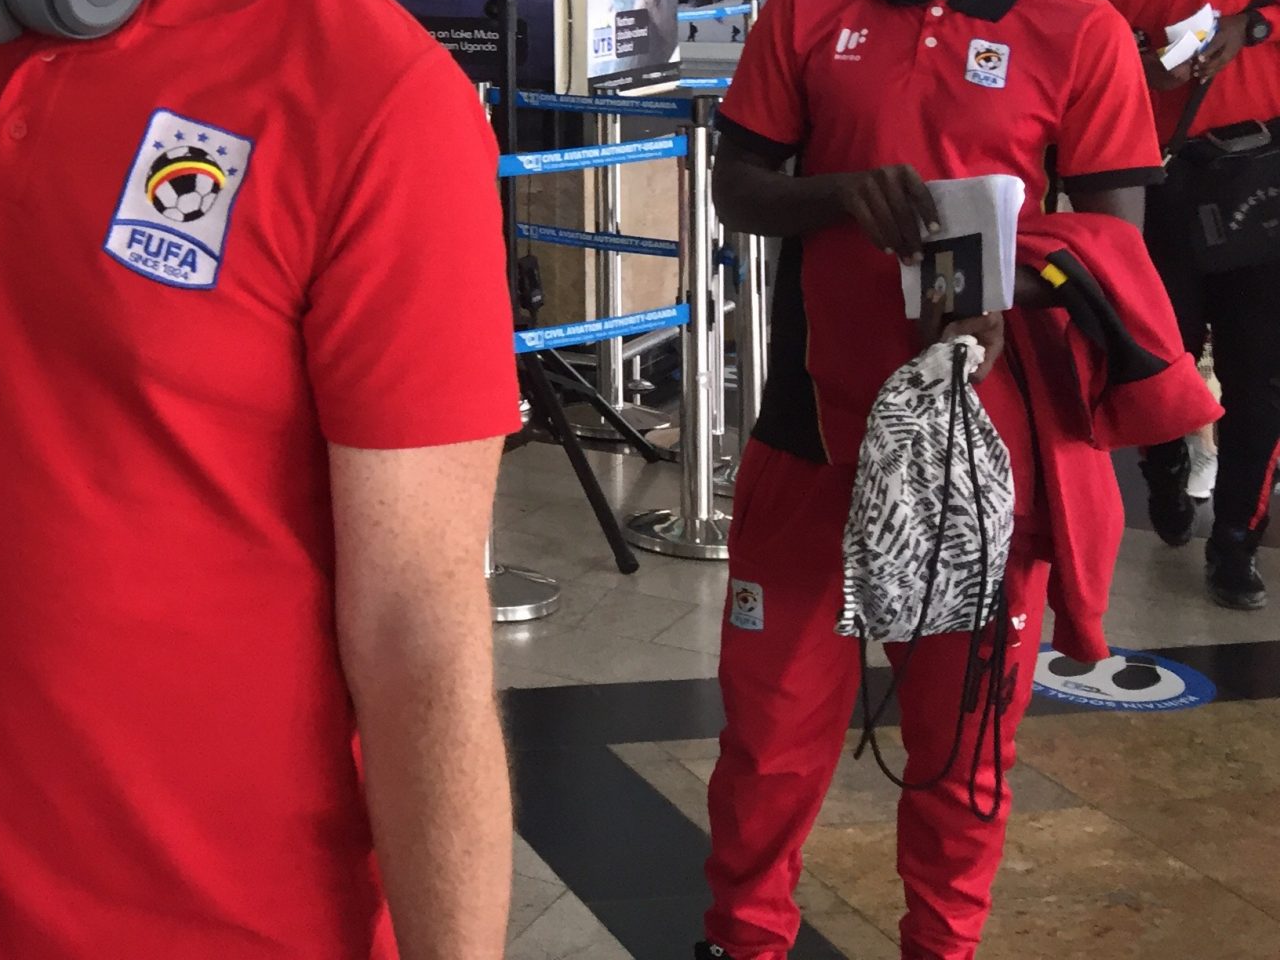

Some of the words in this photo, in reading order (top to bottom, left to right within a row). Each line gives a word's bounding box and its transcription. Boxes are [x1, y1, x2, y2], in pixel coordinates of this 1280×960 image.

[437, 30, 450, 38] on
[450, 29, 473, 39] Lake
[460, 41, 497, 53] Uganda
[542, 153, 563, 163] CIVIL
[563, 149, 600, 161] AVIATION
[126, 228, 197, 273] FUFA
[128, 252, 160, 271] SINCE
[544, 329, 566, 339] CIVIL
[566, 322, 603, 334] AVIATION
[1048, 690, 1117, 708] SOCIAL
